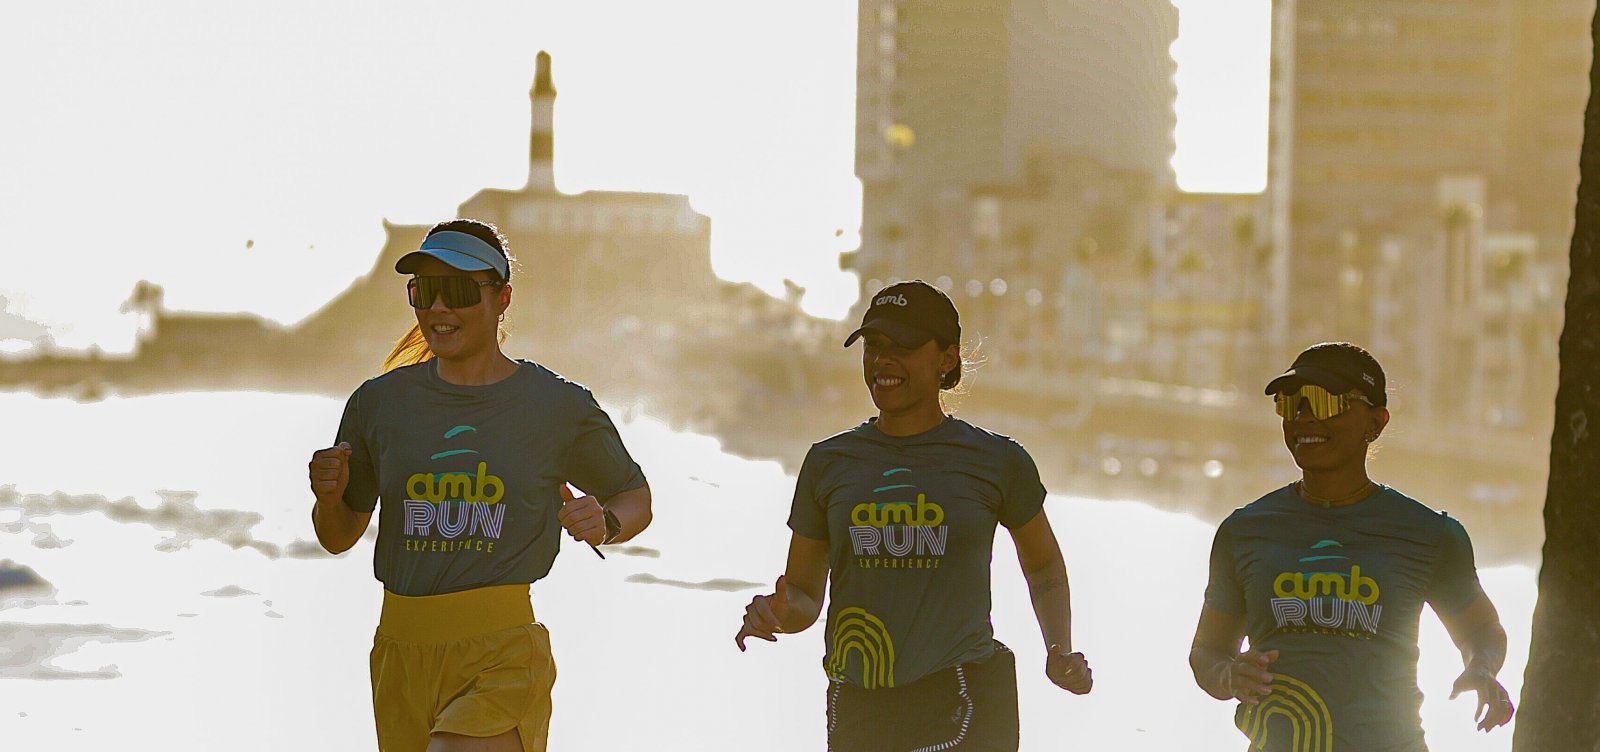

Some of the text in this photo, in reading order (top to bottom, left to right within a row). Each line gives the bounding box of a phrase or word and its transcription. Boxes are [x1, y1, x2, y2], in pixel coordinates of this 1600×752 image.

[875, 293, 908, 307] amb
[406, 461, 505, 505] amb
[403, 499, 506, 539] RUN
[851, 493, 945, 528] amb
[406, 539, 494, 553] EXPERIENCE
[848, 525, 948, 557] RUN
[859, 558, 940, 569] EXPERIENCE
[1273, 565, 1380, 605] amb
[1270, 597, 1382, 635] RUN
